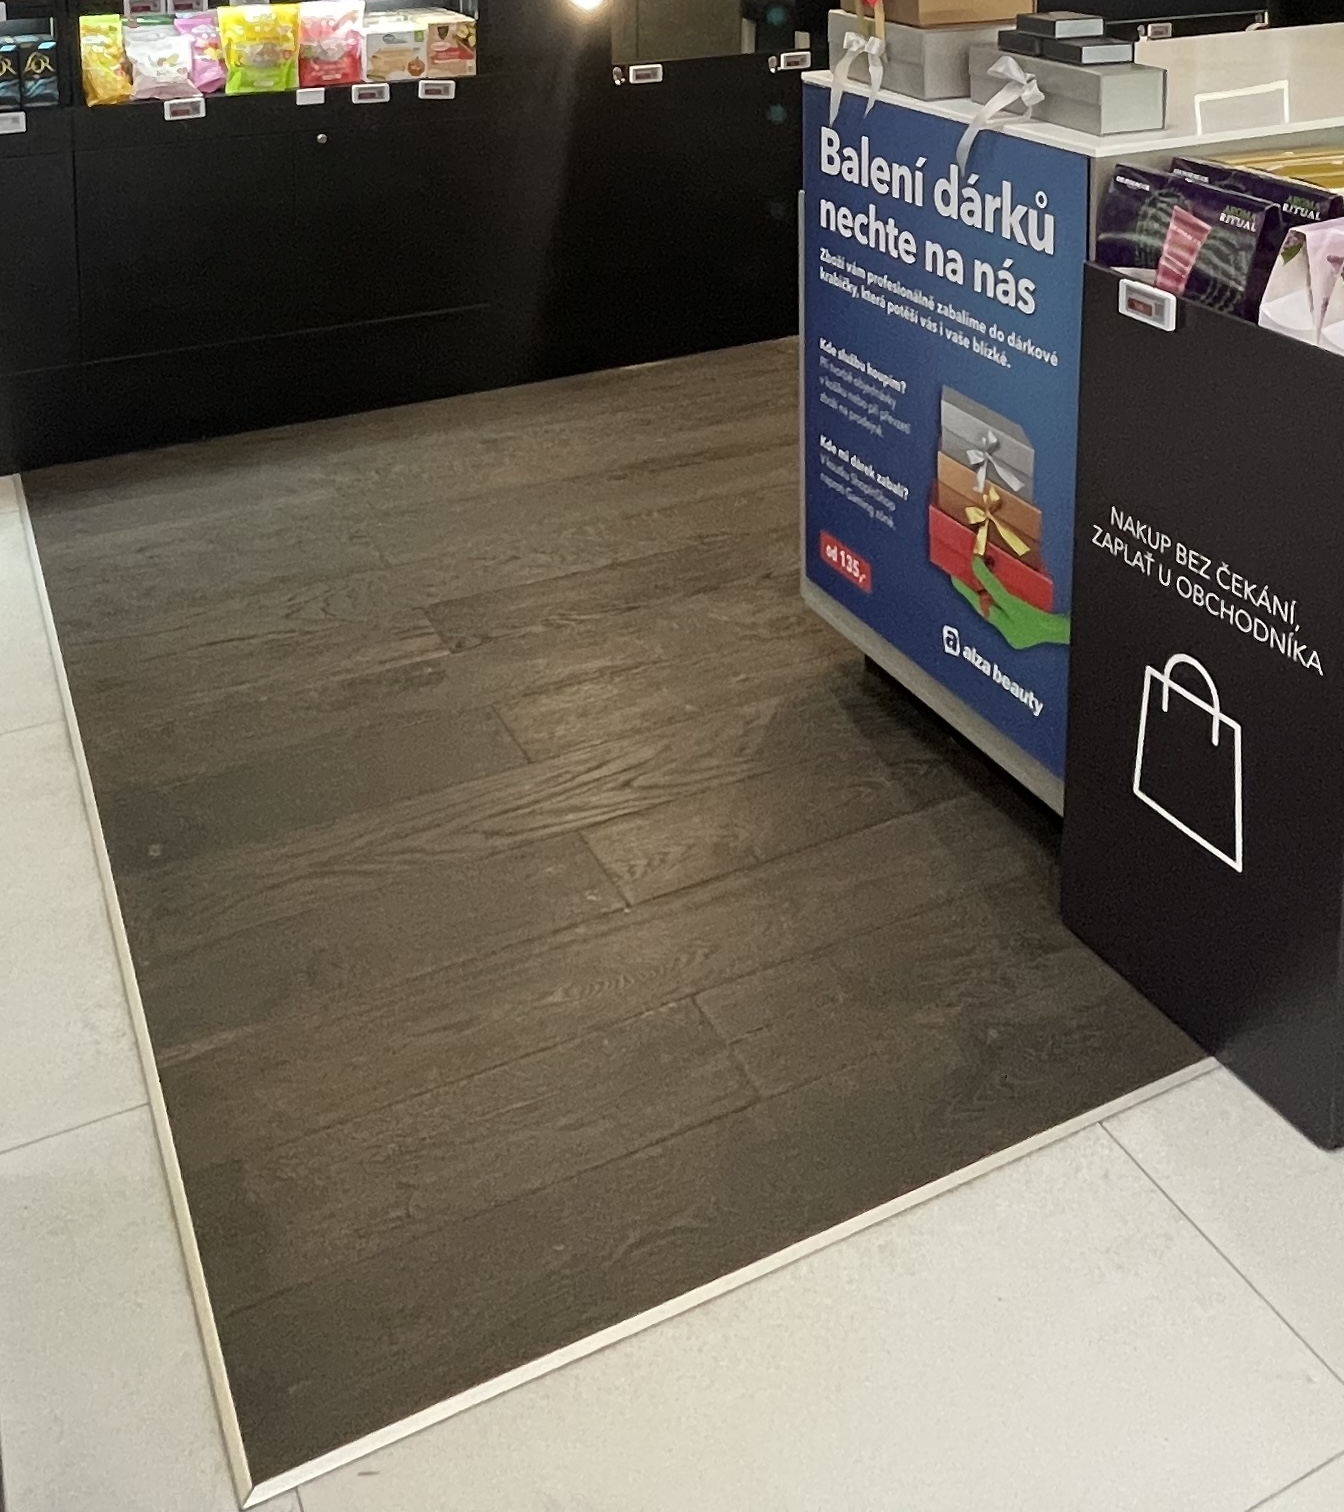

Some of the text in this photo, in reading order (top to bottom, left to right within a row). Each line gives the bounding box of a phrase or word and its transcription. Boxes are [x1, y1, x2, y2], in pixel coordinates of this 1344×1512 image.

[820, 126, 1055, 255] Balení dárků
[1219, 212, 1257, 233] RITUAL
[1282, 202, 1322, 221] RITUAL
[819, 199, 1036, 315] nechte na nás
[846, 261, 866, 279] vám
[867, 272, 936, 311] profesionálně
[937, 302, 987, 335] zabalíme
[989, 324, 1005, 342] do
[1007, 332, 1059, 367] dárkové
[887, 301, 919, 324] potěší
[920, 316, 938, 334] vás
[939, 321, 944, 336] i
[945, 328, 971, 349] vaše
[972, 336, 1012, 369] blízké.
[1092, 524, 1324, 676] ZAPLAŤ U OBCHODNÍKA
[1110, 506, 1301, 632] NAKUP BEZ ČEKÁNÍ,
[962, 646, 992, 677] alza
[992, 663, 1044, 717] beauty
